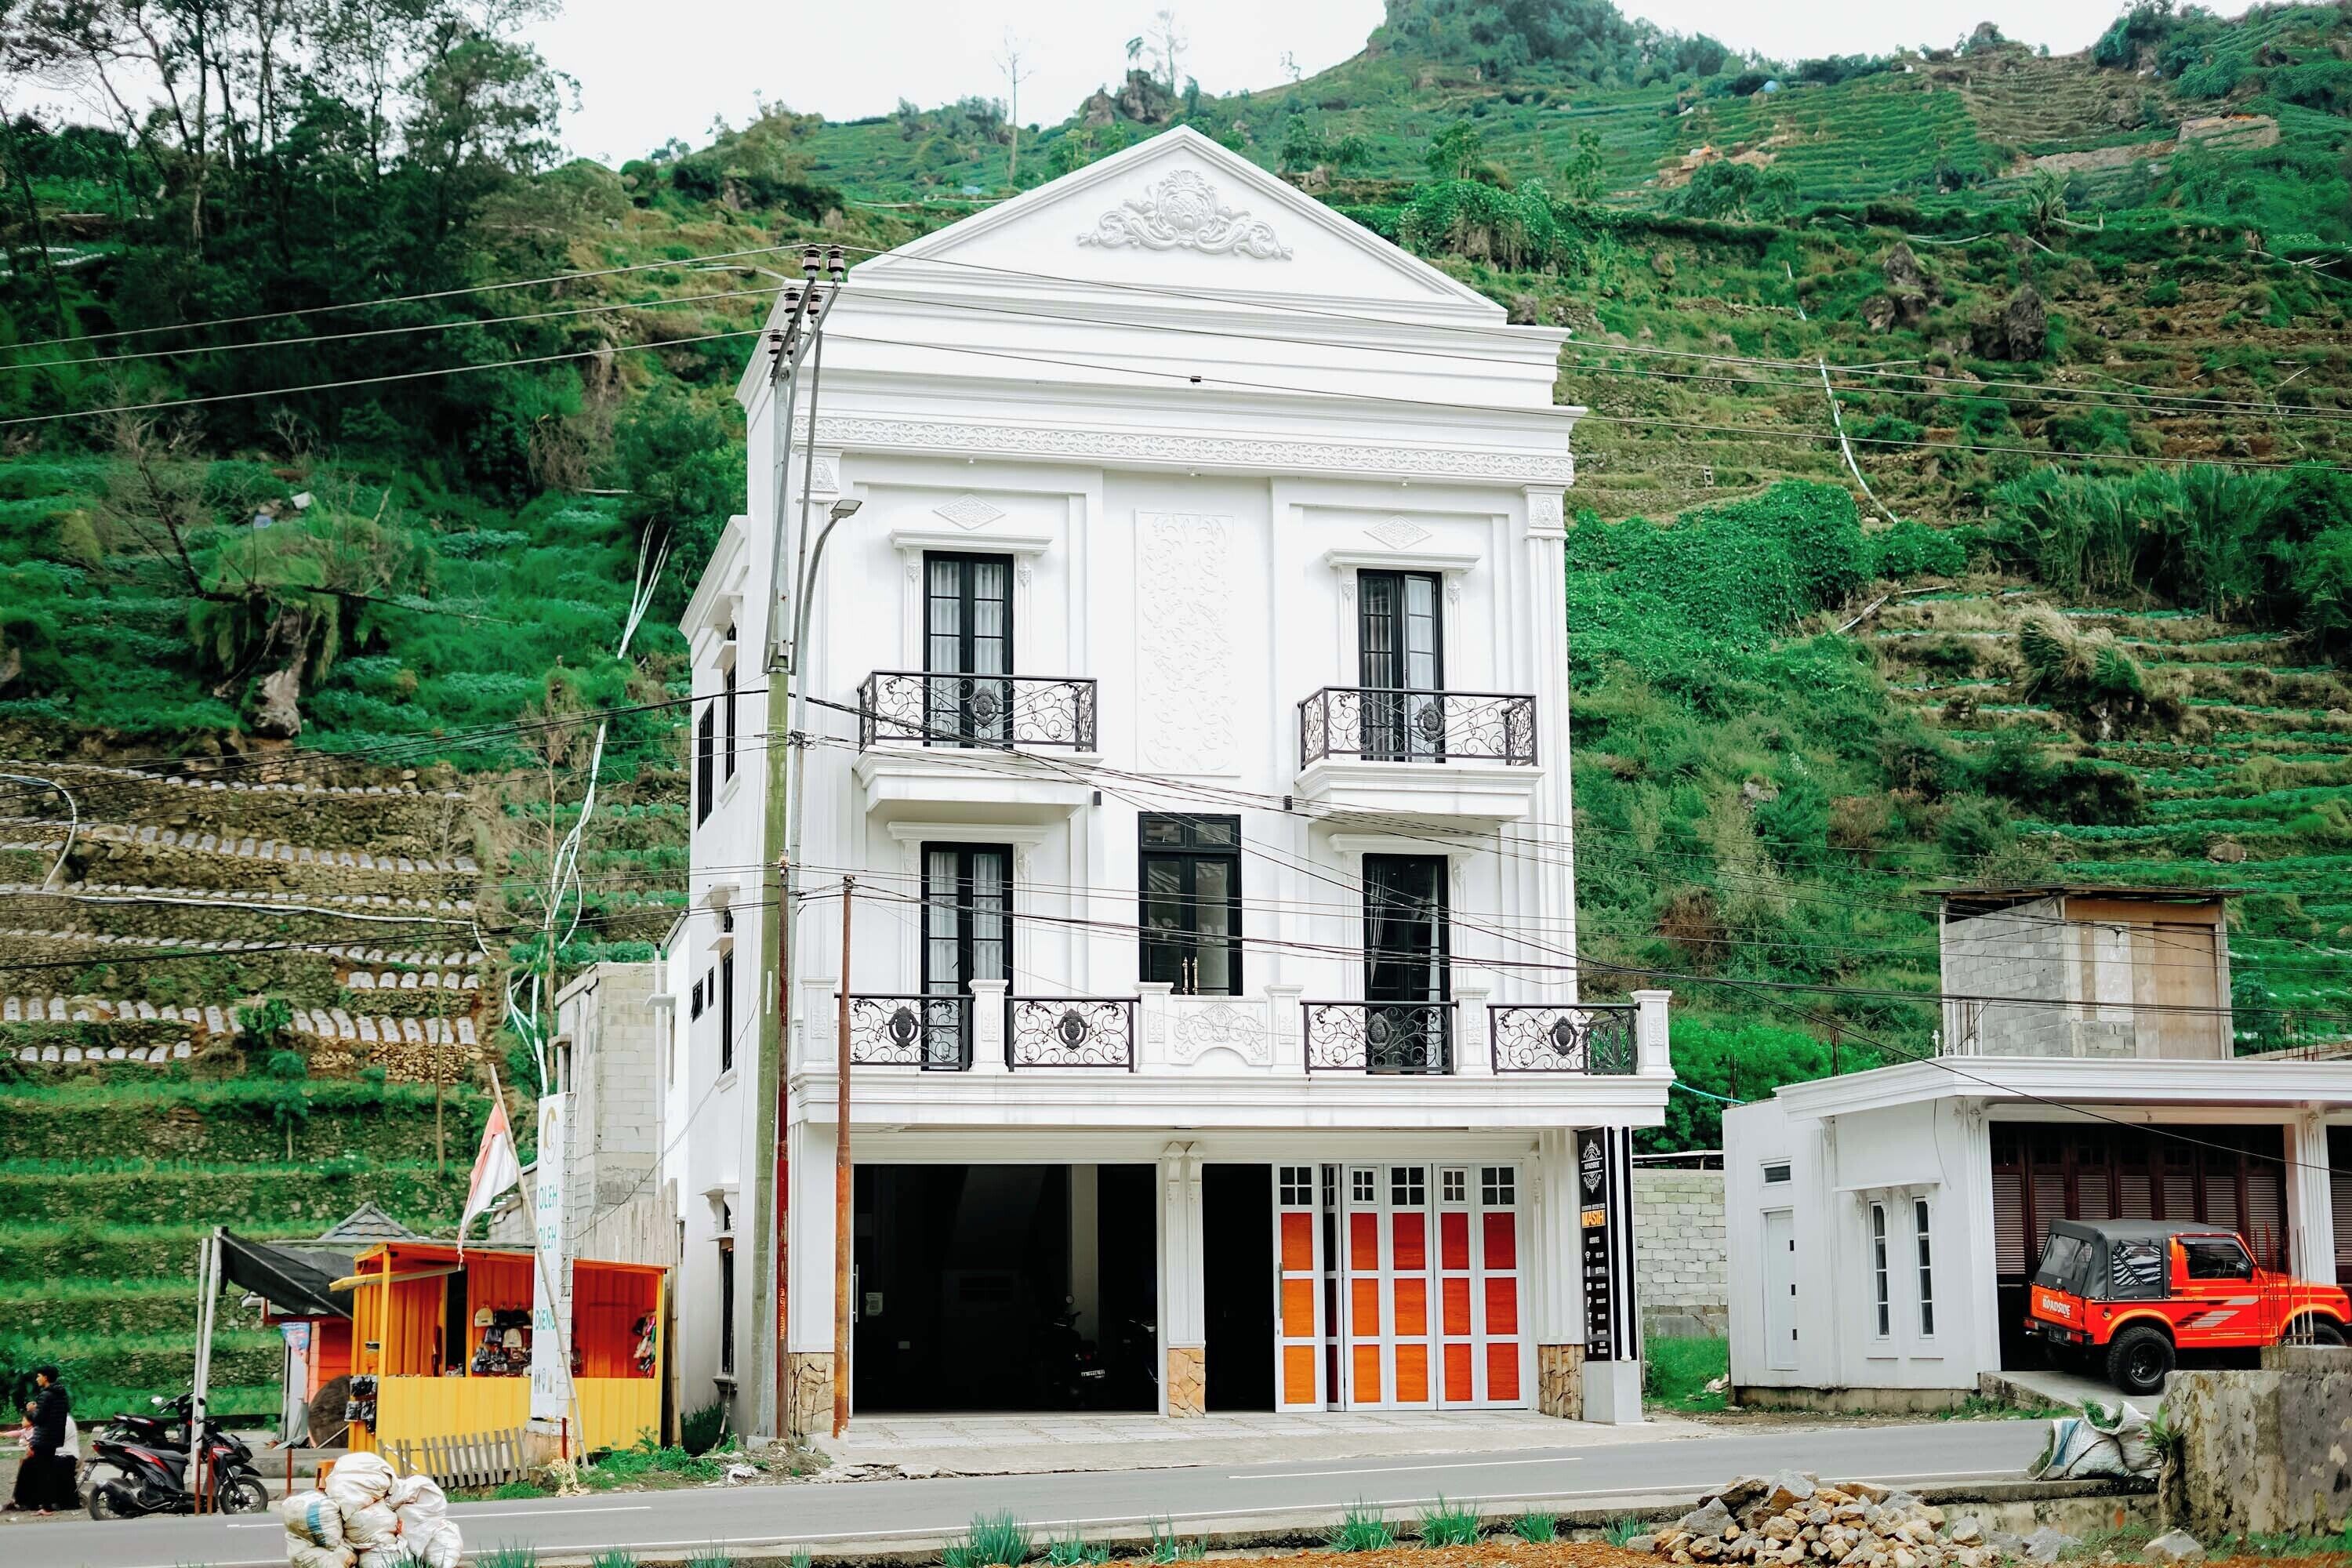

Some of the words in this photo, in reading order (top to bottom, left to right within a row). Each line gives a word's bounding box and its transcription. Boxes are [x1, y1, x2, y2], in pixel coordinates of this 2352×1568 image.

[539, 1184, 558, 1209] OLEH
[538, 1224, 557, 1250] OLEH
[2042, 1297, 2071, 1316] ROADSIDE
